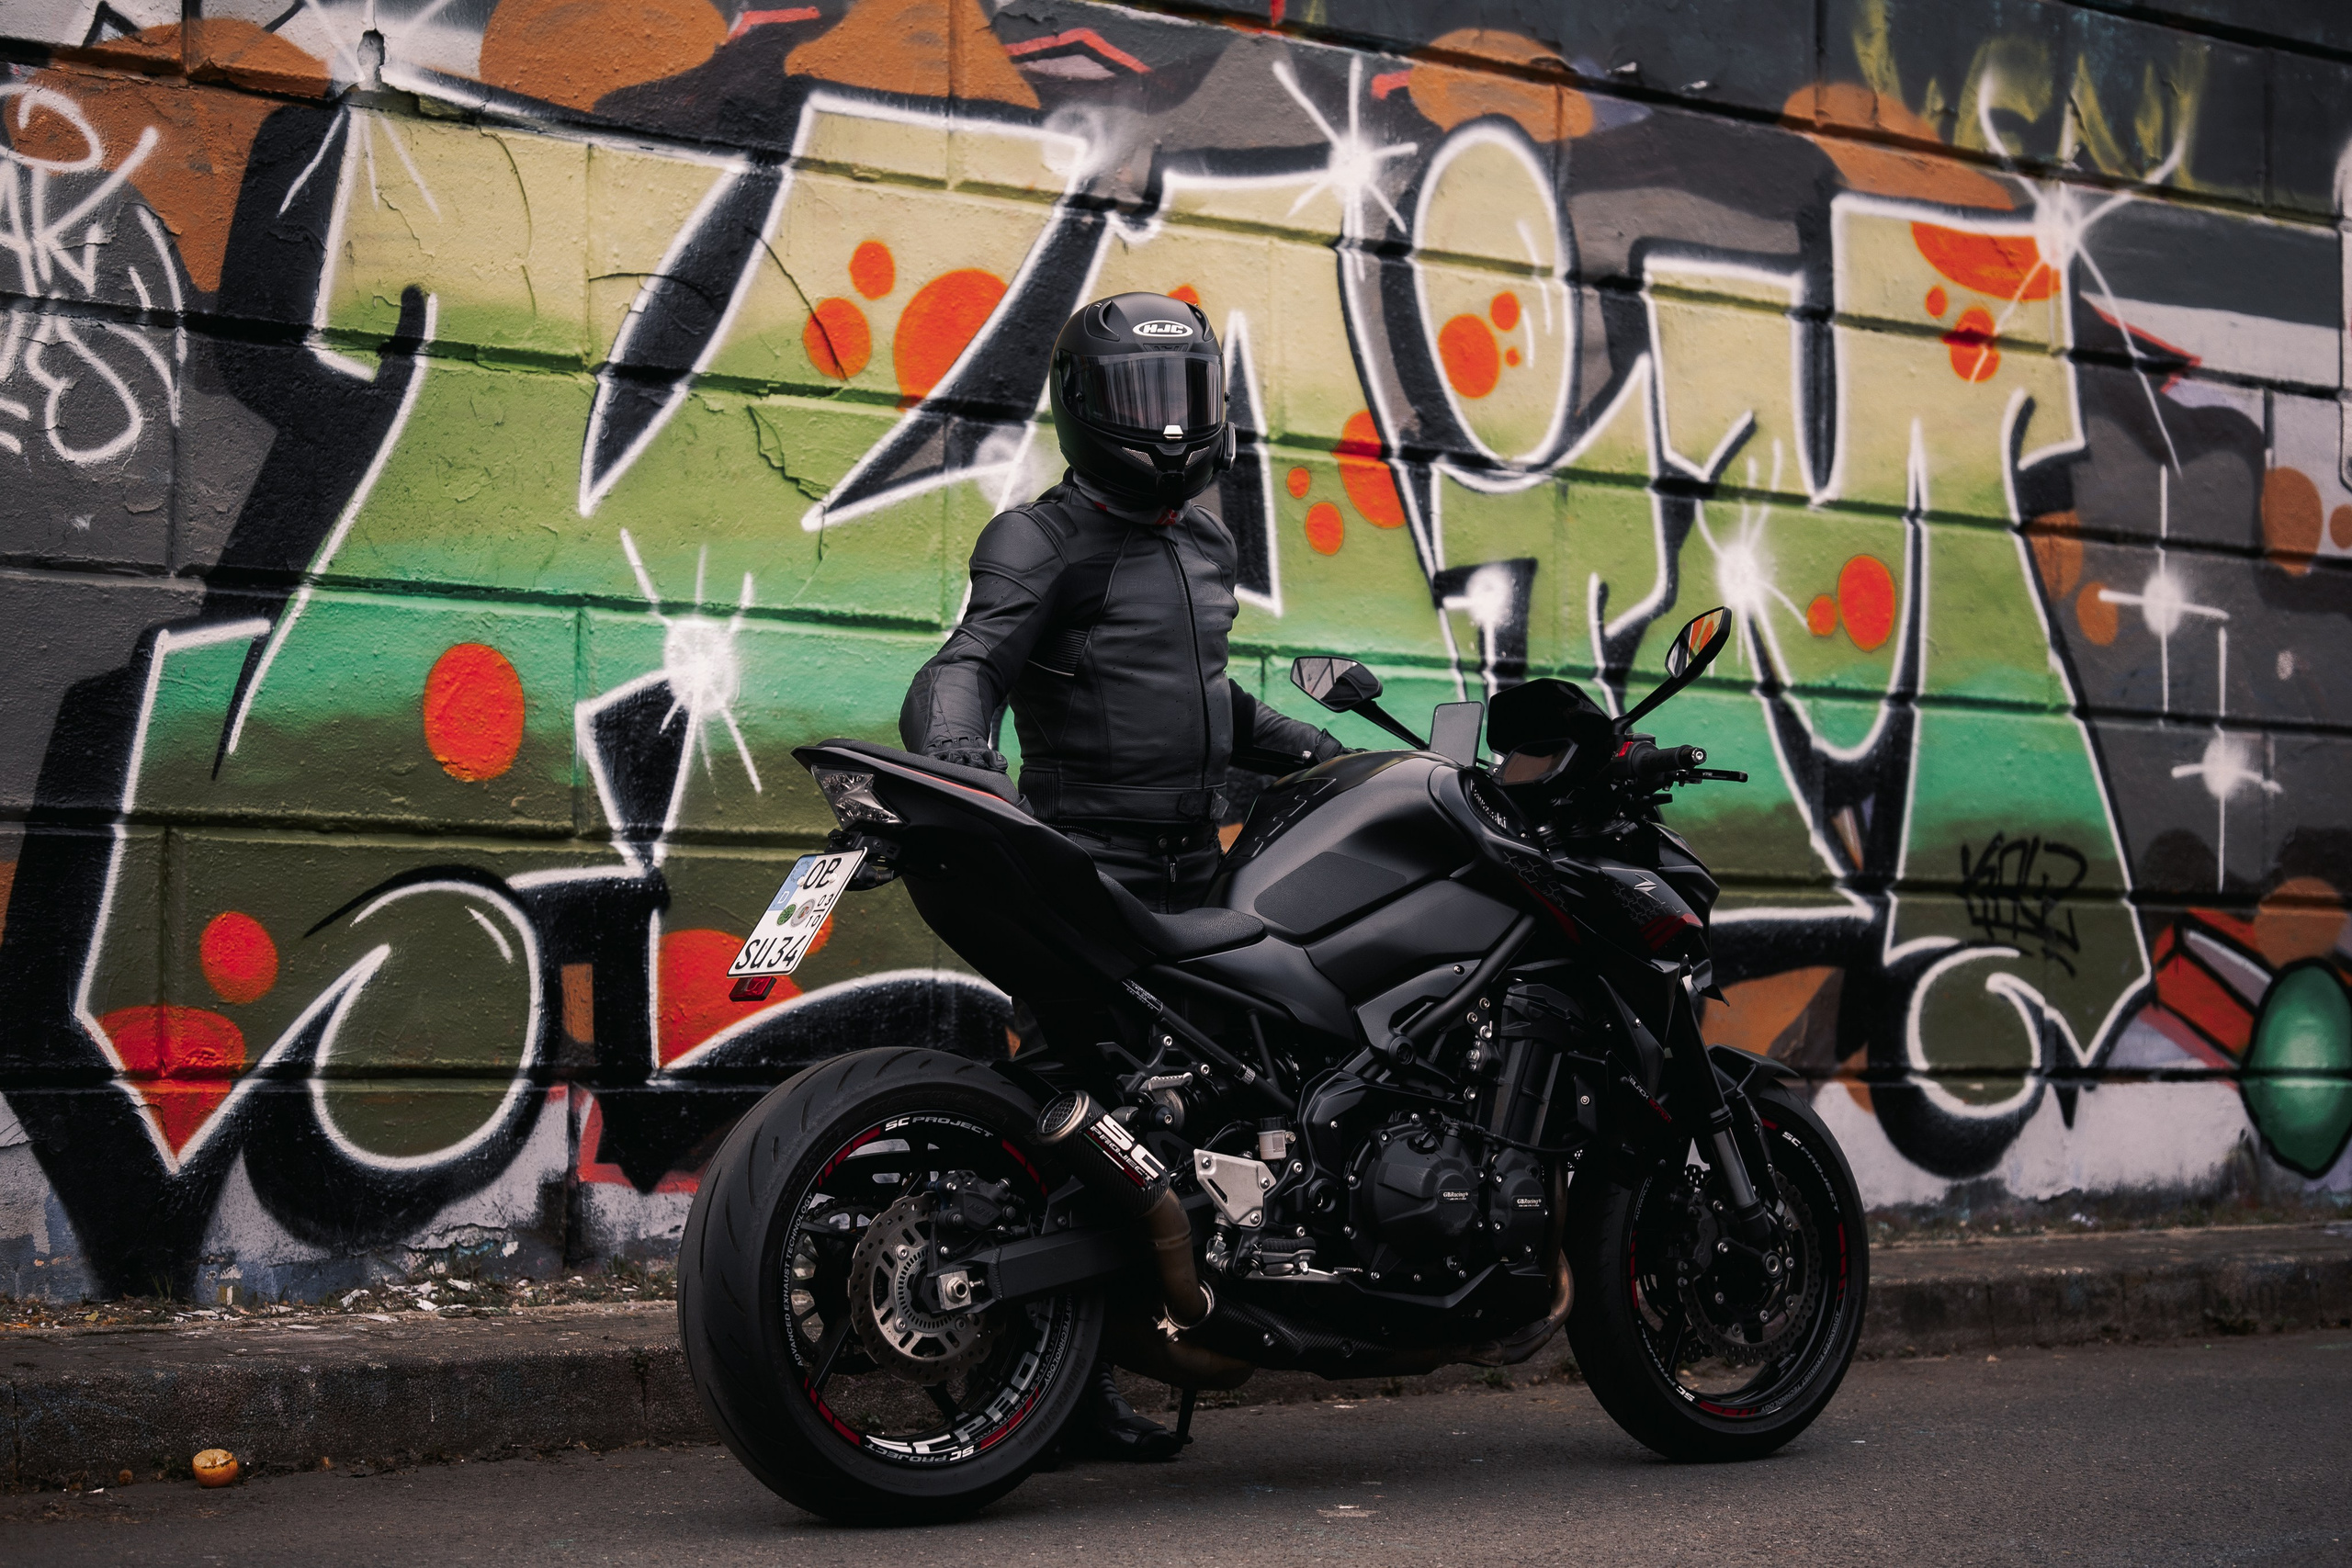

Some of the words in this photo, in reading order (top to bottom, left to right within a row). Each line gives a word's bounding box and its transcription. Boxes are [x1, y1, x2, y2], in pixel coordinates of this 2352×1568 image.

[1143, 324, 1183, 333] HJC
[803, 857, 842, 890] OB
[777, 891, 790, 905] D
[817, 893, 834, 908] 03
[805, 914, 821, 929] 10
[734, 937, 778, 970] SU
[767, 934, 807, 967] 34
[885, 1117, 910, 1132] SC
[911, 1116, 994, 1138] PROJECT
[1090, 1125, 1154, 1181] PROJECT
[1095, 1113, 1166, 1179] SC
[1782, 1131, 1802, 1147] SC
[1801, 1145, 1840, 1213] PROJECT
[786, 1191, 814, 1264] TECHNOLOGY
[783, 1266, 791, 1313] EXHAUST
[784, 1314, 804, 1367] ADVANCED
[1823, 1309, 1840, 1355] ADVANCED
[1044, 1320, 1071, 1387] TECHNOLOGY
[1802, 1353, 1825, 1386] EXHAUST
[1759, 1383, 1802, 1414] TECHNOLOGY
[864, 1443, 947, 1462] PROJECT
[949, 1444, 975, 1461] SC
